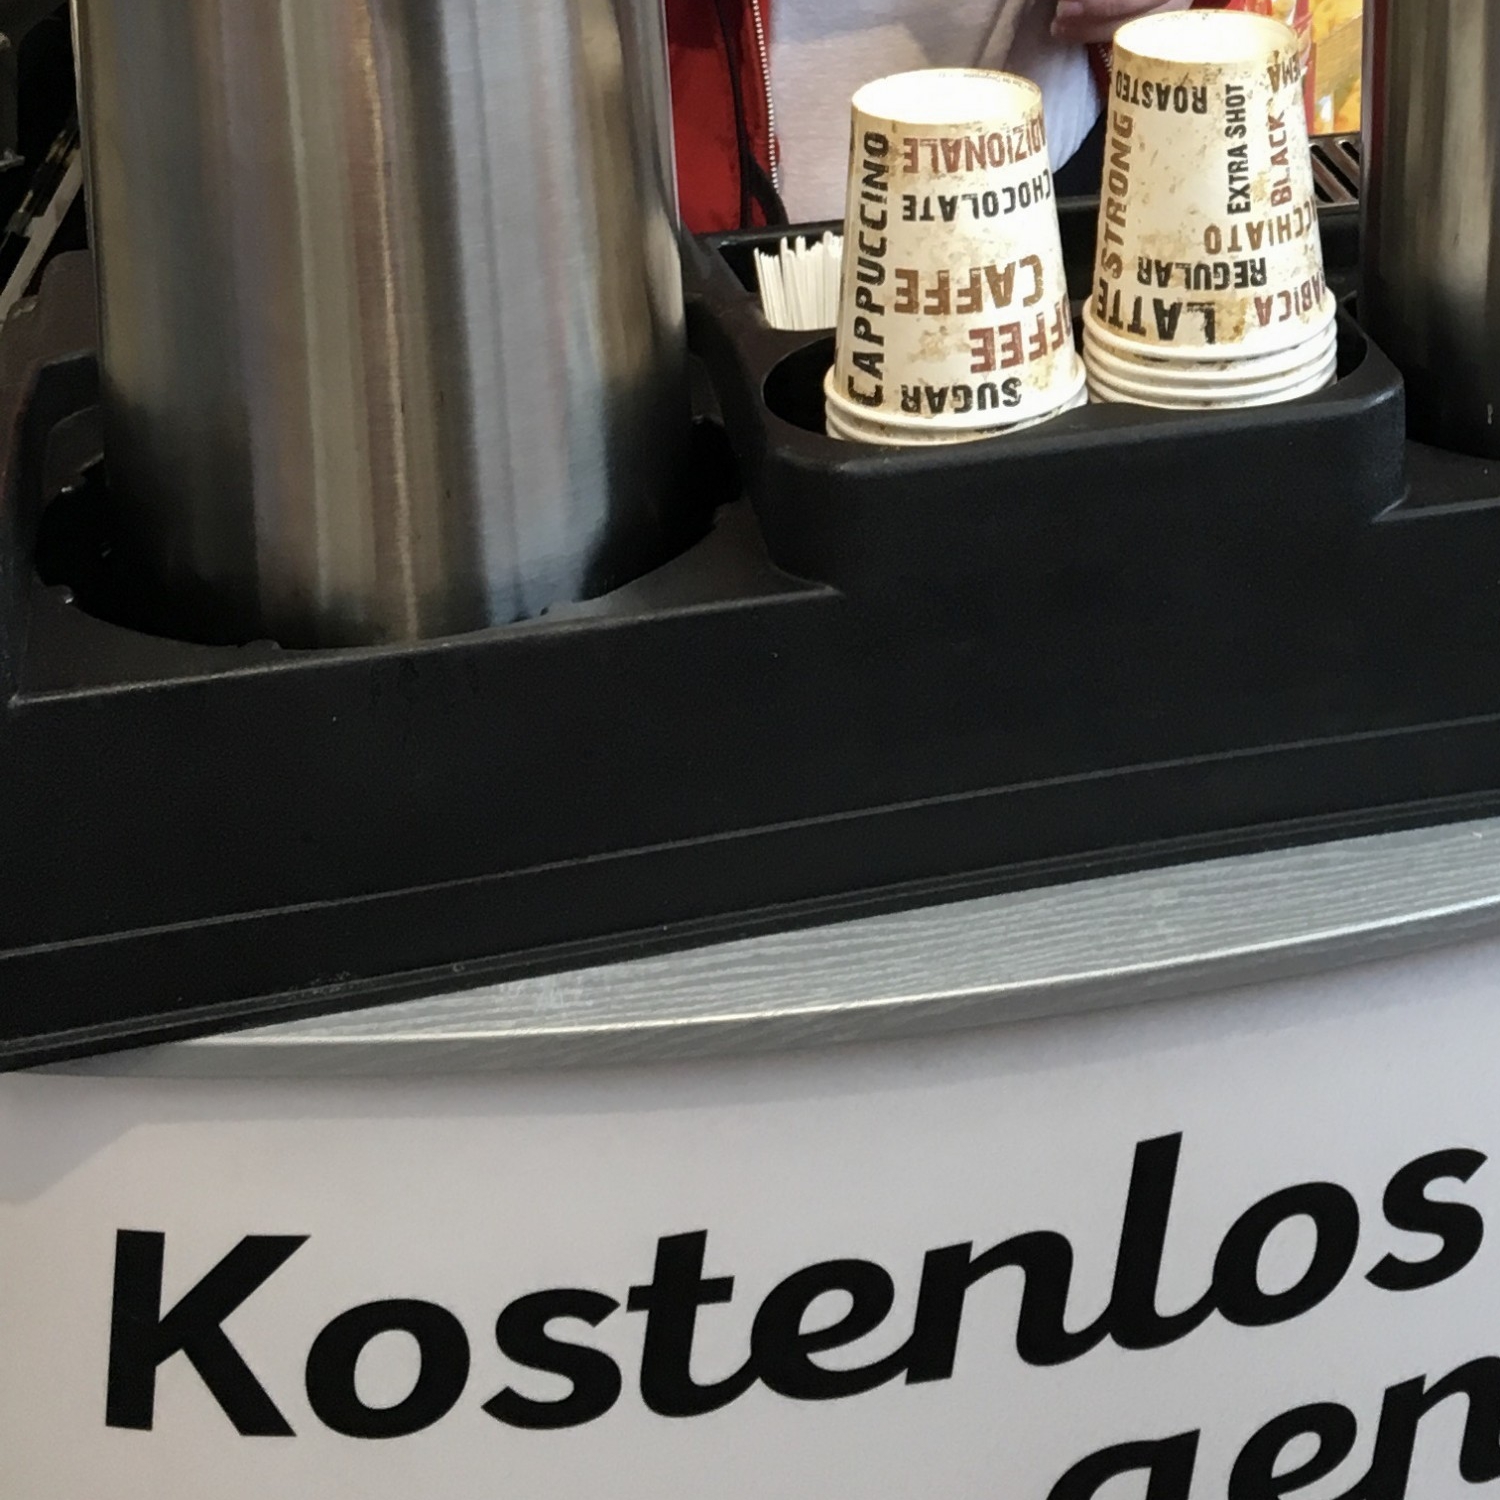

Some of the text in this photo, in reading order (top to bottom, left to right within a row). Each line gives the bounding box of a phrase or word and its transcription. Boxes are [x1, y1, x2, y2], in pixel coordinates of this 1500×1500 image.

[1116, 70, 1208, 115] ROASTED
[1225, 83, 1251, 216] EXTRA SHOT
[1267, 108, 1293, 208] BLACK
[902, 168, 1052, 222] CHOCOLATE
[1101, 110, 1134, 280] STRONG
[847, 130, 890, 408] CAPPUCCINO
[894, 254, 1044, 316] CAFFE
[1137, 256, 1268, 291] REGULAR
[1096, 277, 1216, 345] LATTE
[901, 377, 1022, 414] SUGAR
[105, 1131, 1489, 1440] Kostenlos
